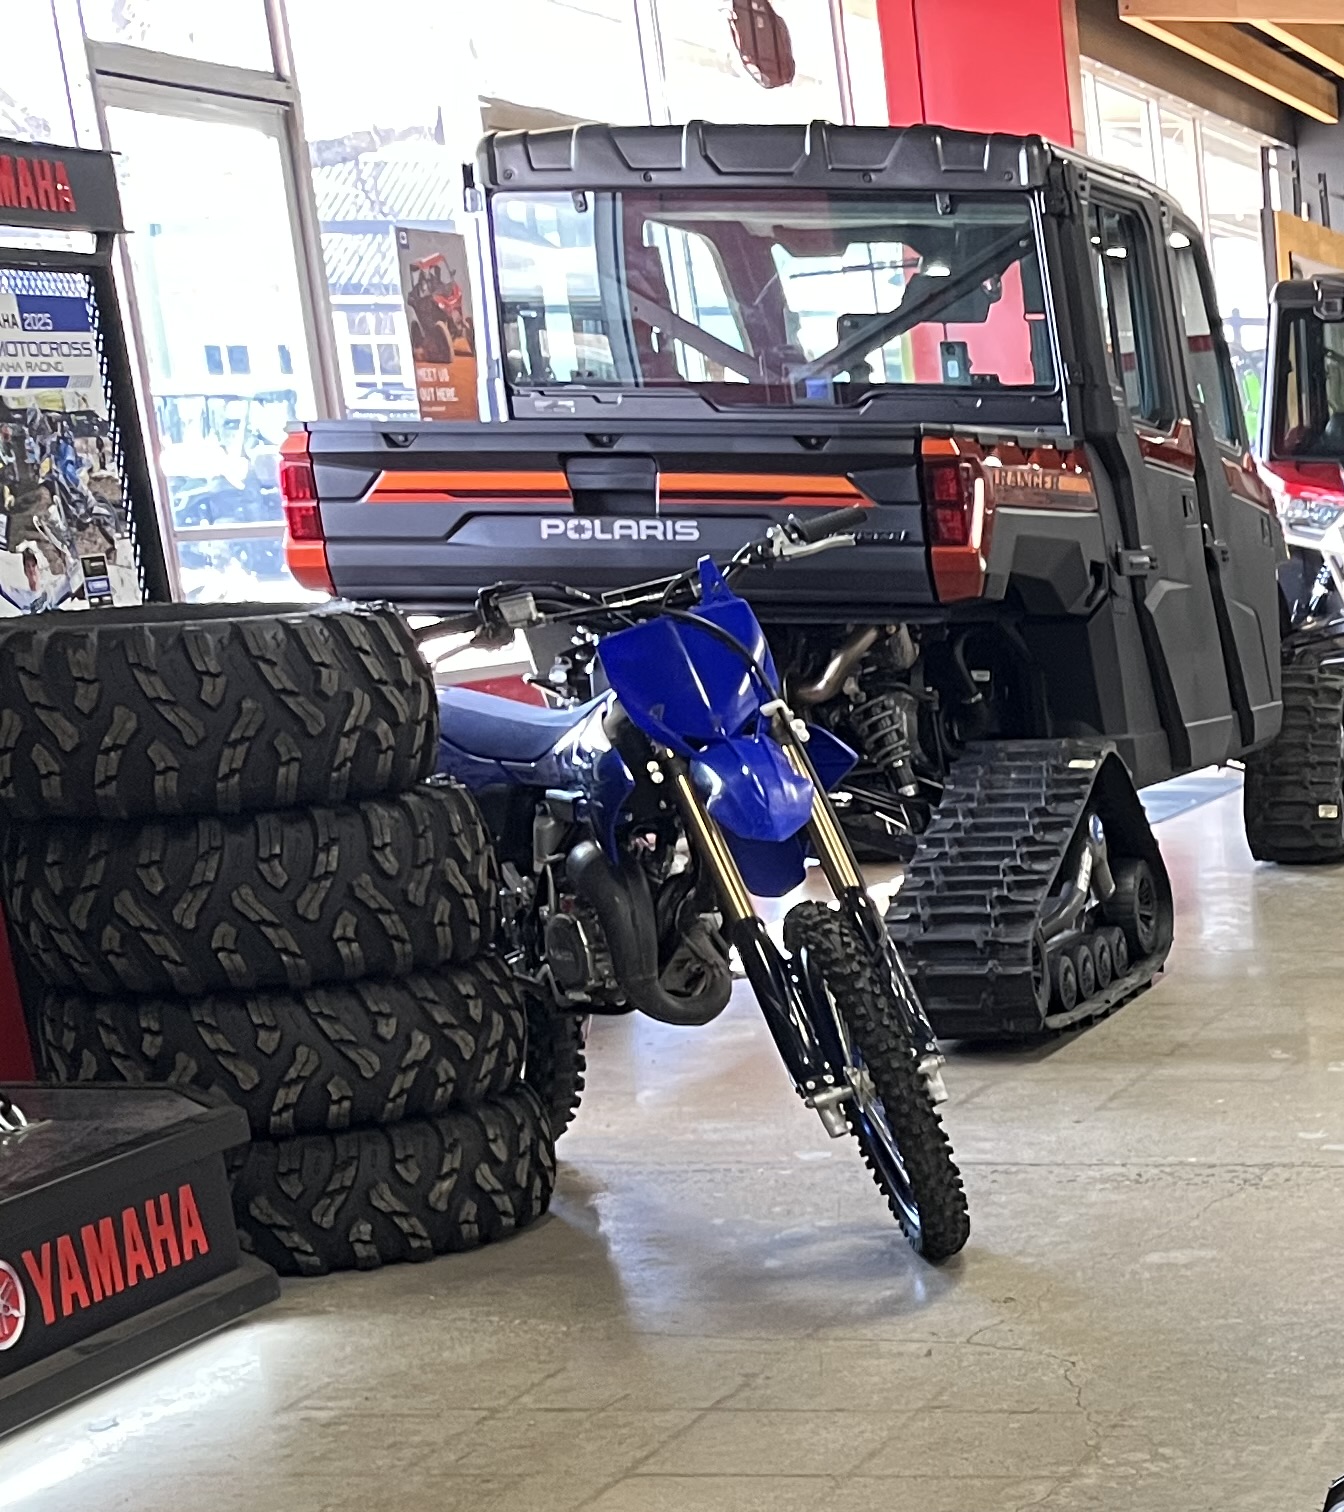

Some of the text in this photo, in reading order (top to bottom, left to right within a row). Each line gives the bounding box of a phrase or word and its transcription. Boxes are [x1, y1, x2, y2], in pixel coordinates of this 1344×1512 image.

[0, 154, 77, 212] MAHA
[22, 312, 53, 330] 2025
[25, 361, 64, 373] RACING
[540, 518, 700, 541] POLARIS
[22, 1183, 208, 1326] YAMAHA
